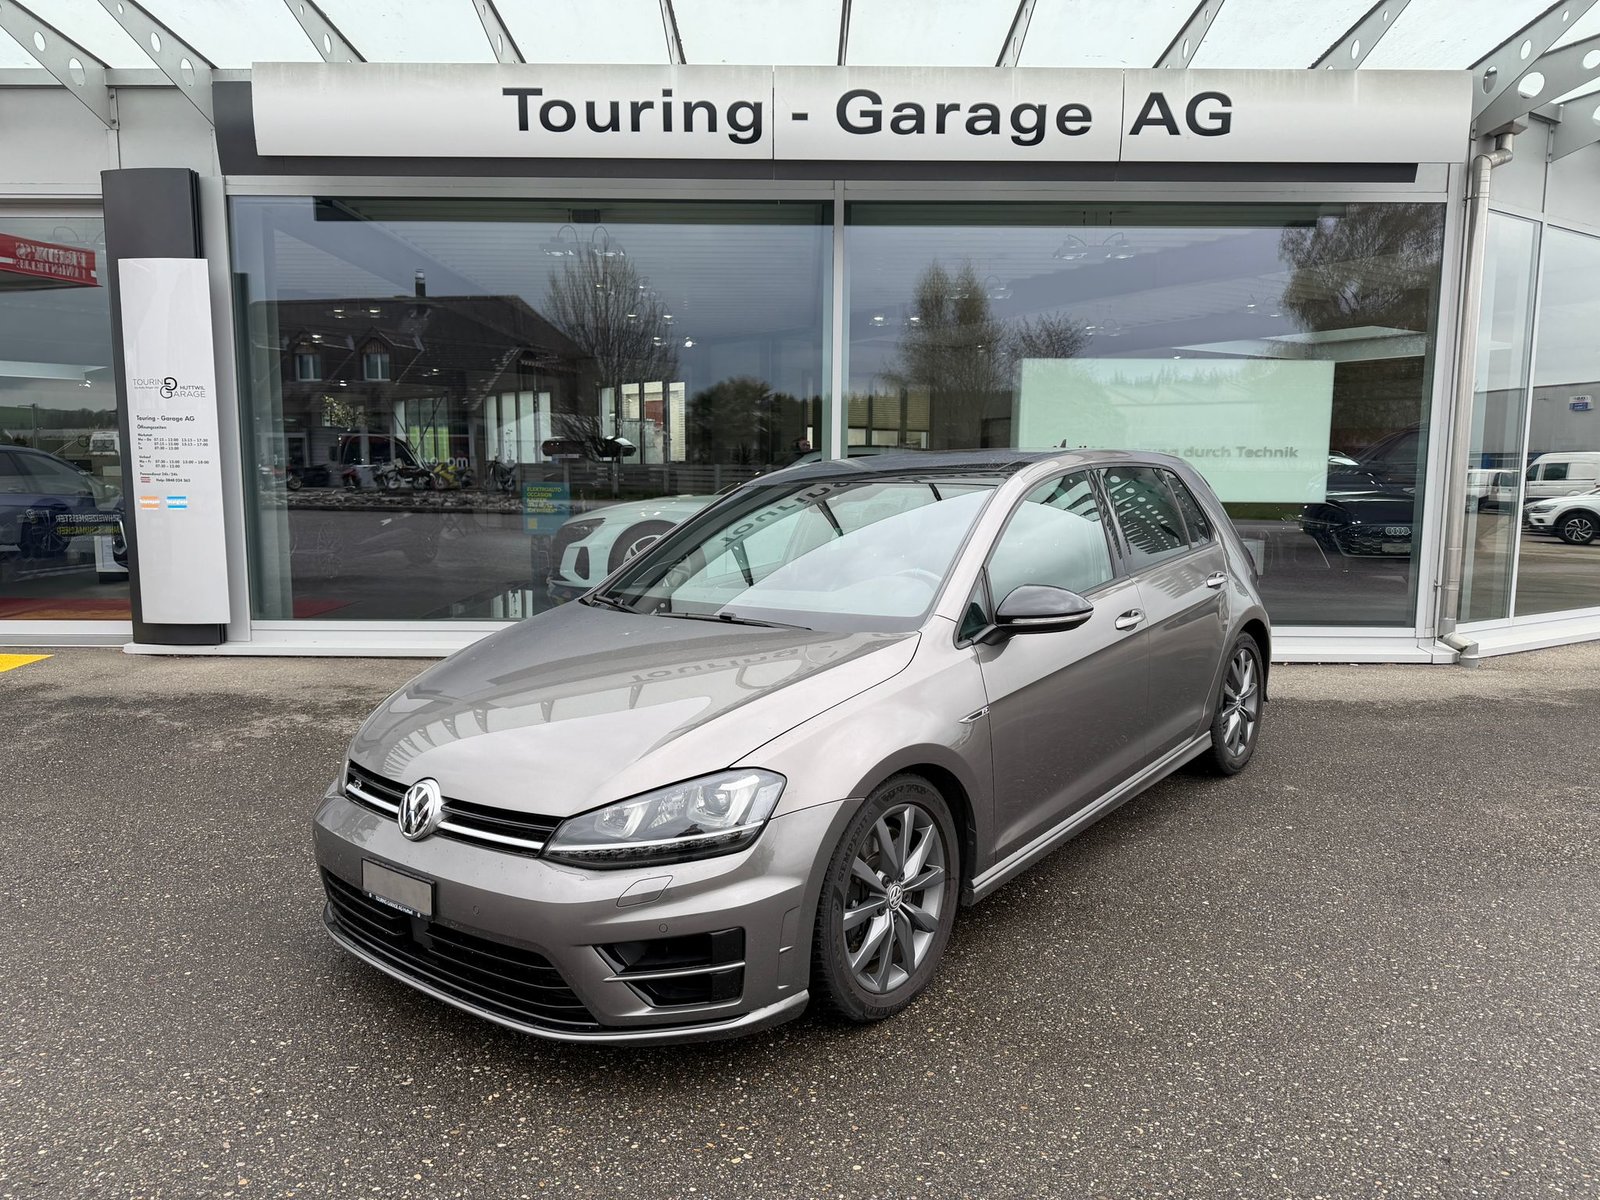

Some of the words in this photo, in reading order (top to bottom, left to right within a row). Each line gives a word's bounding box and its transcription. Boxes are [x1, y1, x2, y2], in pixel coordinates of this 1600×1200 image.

[502, 87, 763, 145] Touring
[791, 112, 808, 121] -
[836, 88, 1092, 146] Garage
[1128, 91, 1232, 137] AG
[160, 415, 184, 423] Garage
[1183, 446, 1232, 458] durch
[1235, 446, 1299, 459] Technik
